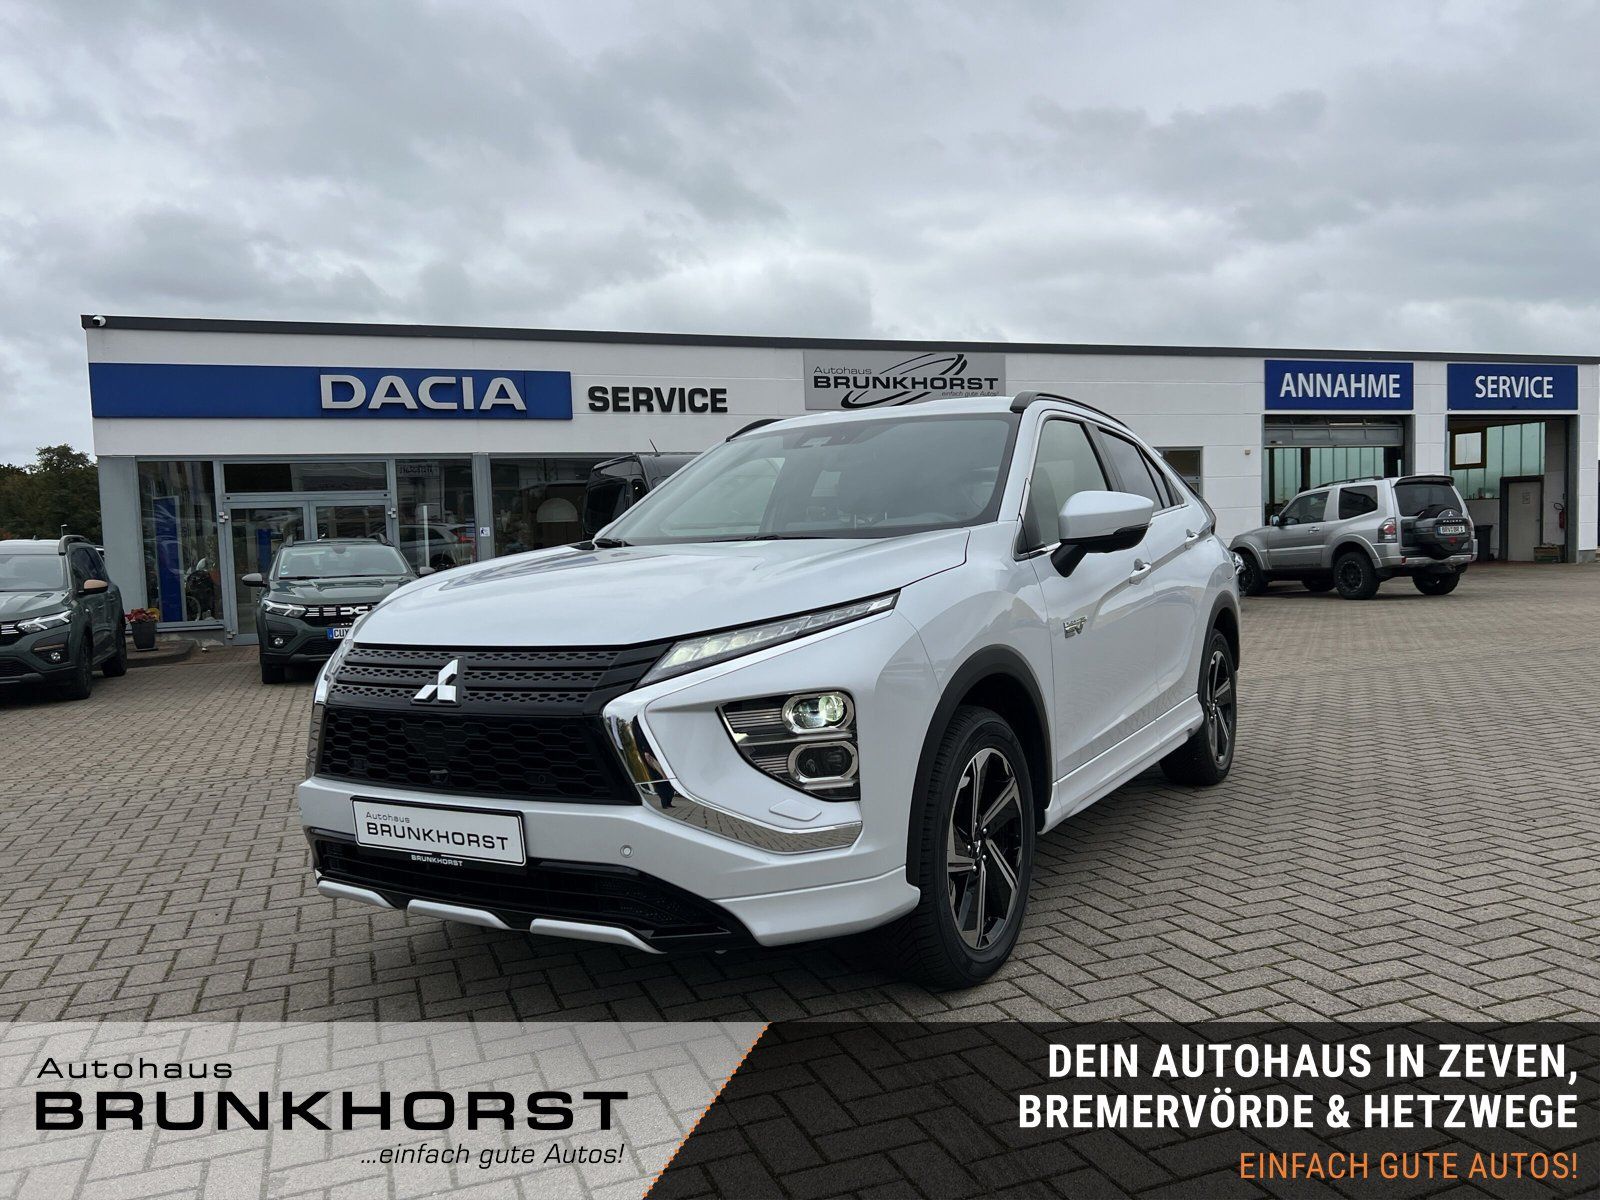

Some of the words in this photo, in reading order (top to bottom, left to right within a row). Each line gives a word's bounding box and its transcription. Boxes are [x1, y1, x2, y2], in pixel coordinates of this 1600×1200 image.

[813, 365, 872, 375] Autohaus
[319, 374, 527, 411] DACIA
[813, 375, 999, 390] BRUNKHORST
[1280, 372, 1401, 399] ANNAHME
[1475, 375, 1554, 399] SERVICE
[587, 385, 728, 414] SERVICE
[365, 811, 411, 824] Autohaus
[366, 822, 508, 850] BRUNKHORST
[411, 854, 463, 867] BRUNKHORST
